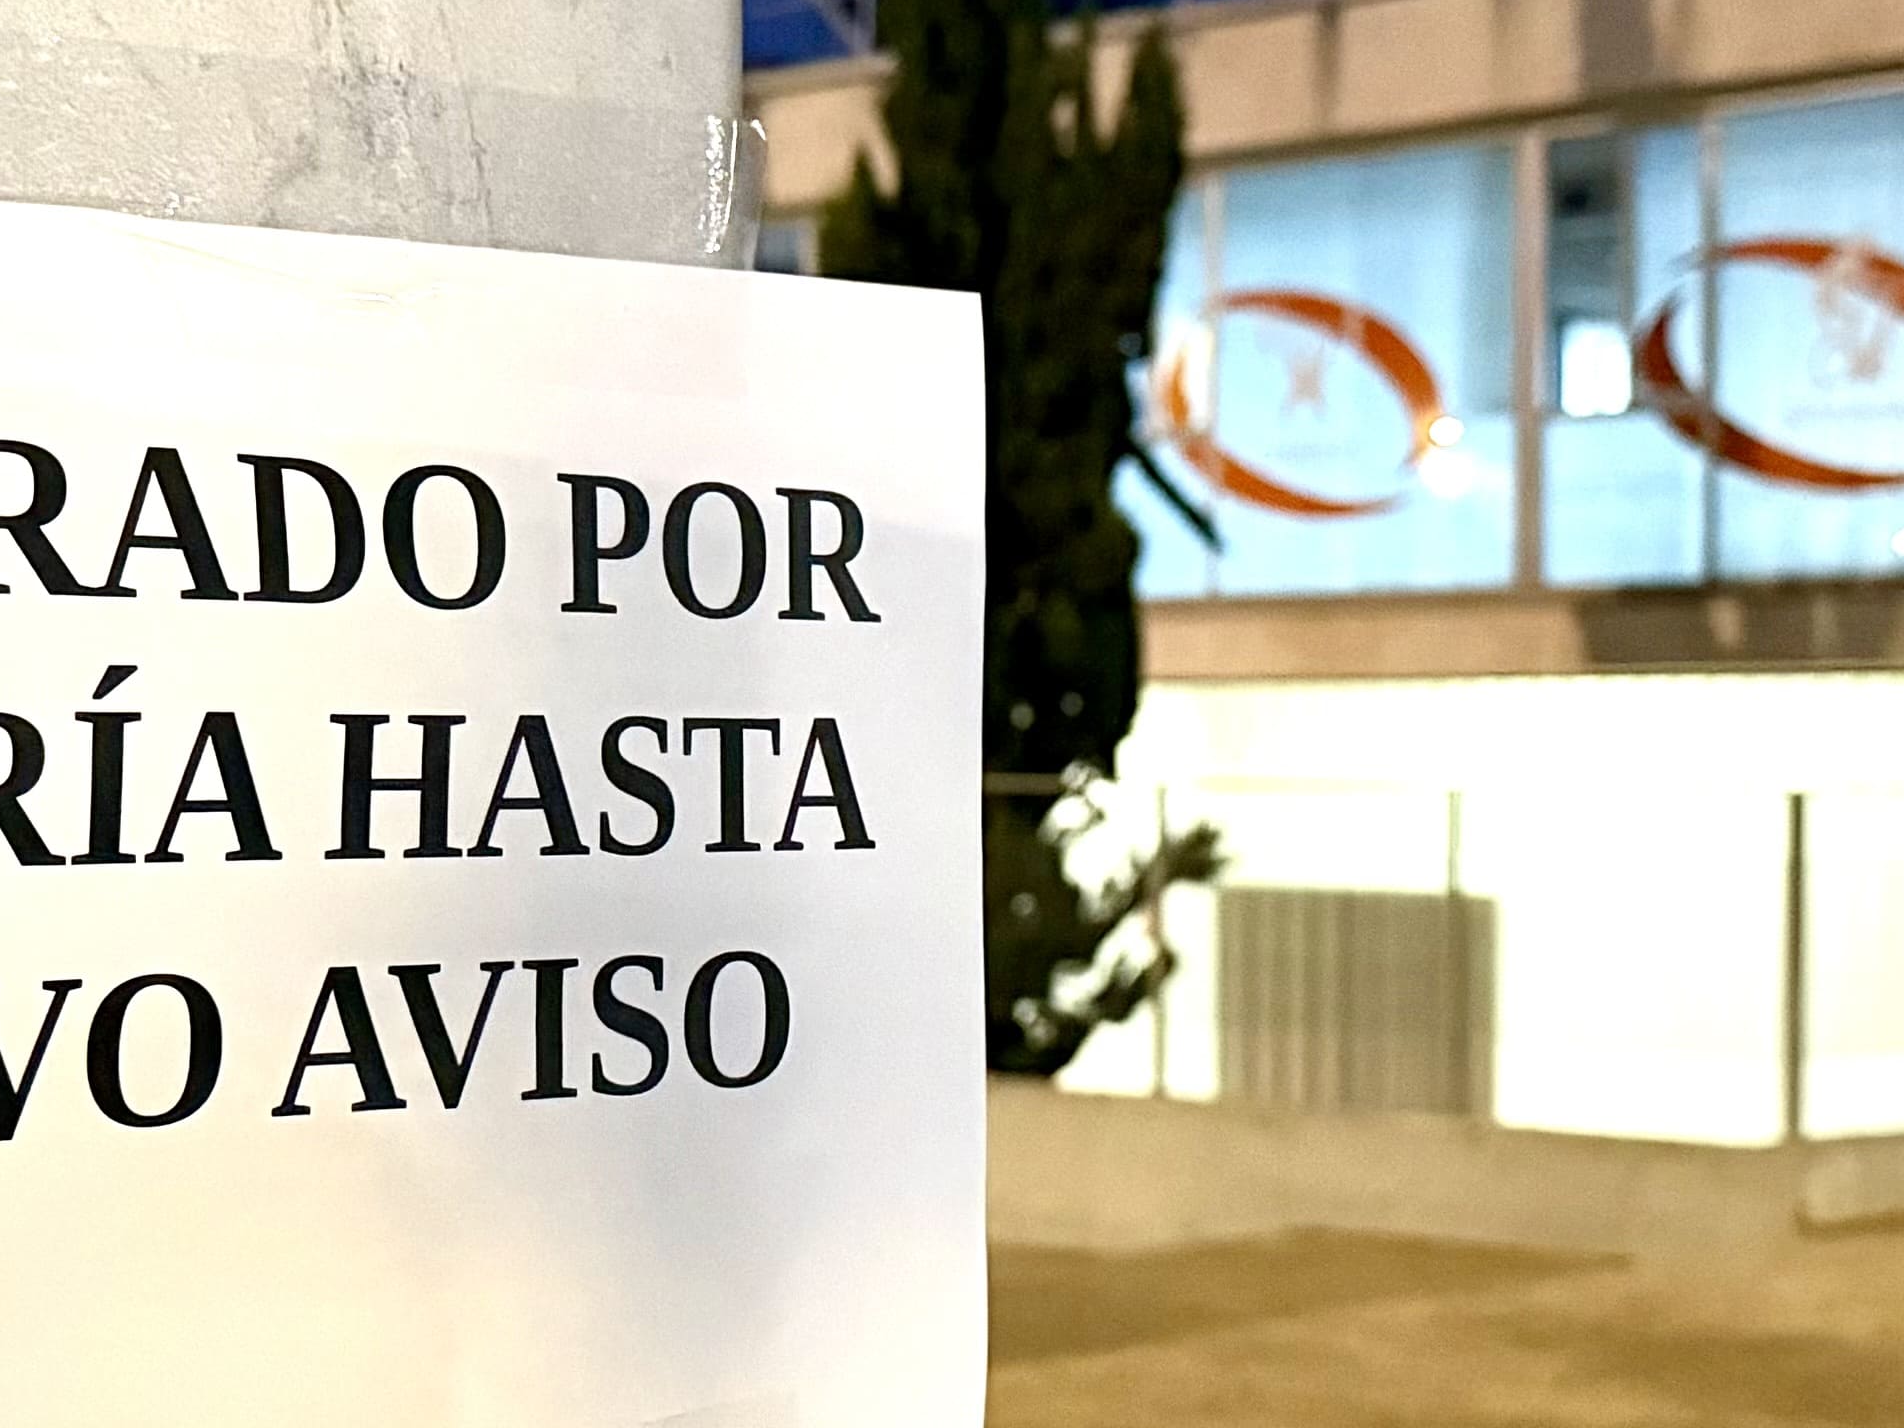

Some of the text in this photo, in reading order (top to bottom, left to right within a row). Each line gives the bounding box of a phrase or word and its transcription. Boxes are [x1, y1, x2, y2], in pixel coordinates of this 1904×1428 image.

[556, 472, 882, 623] POR
[324, 713, 876, 860] HASTA
[271, 950, 791, 1117] AVISO
